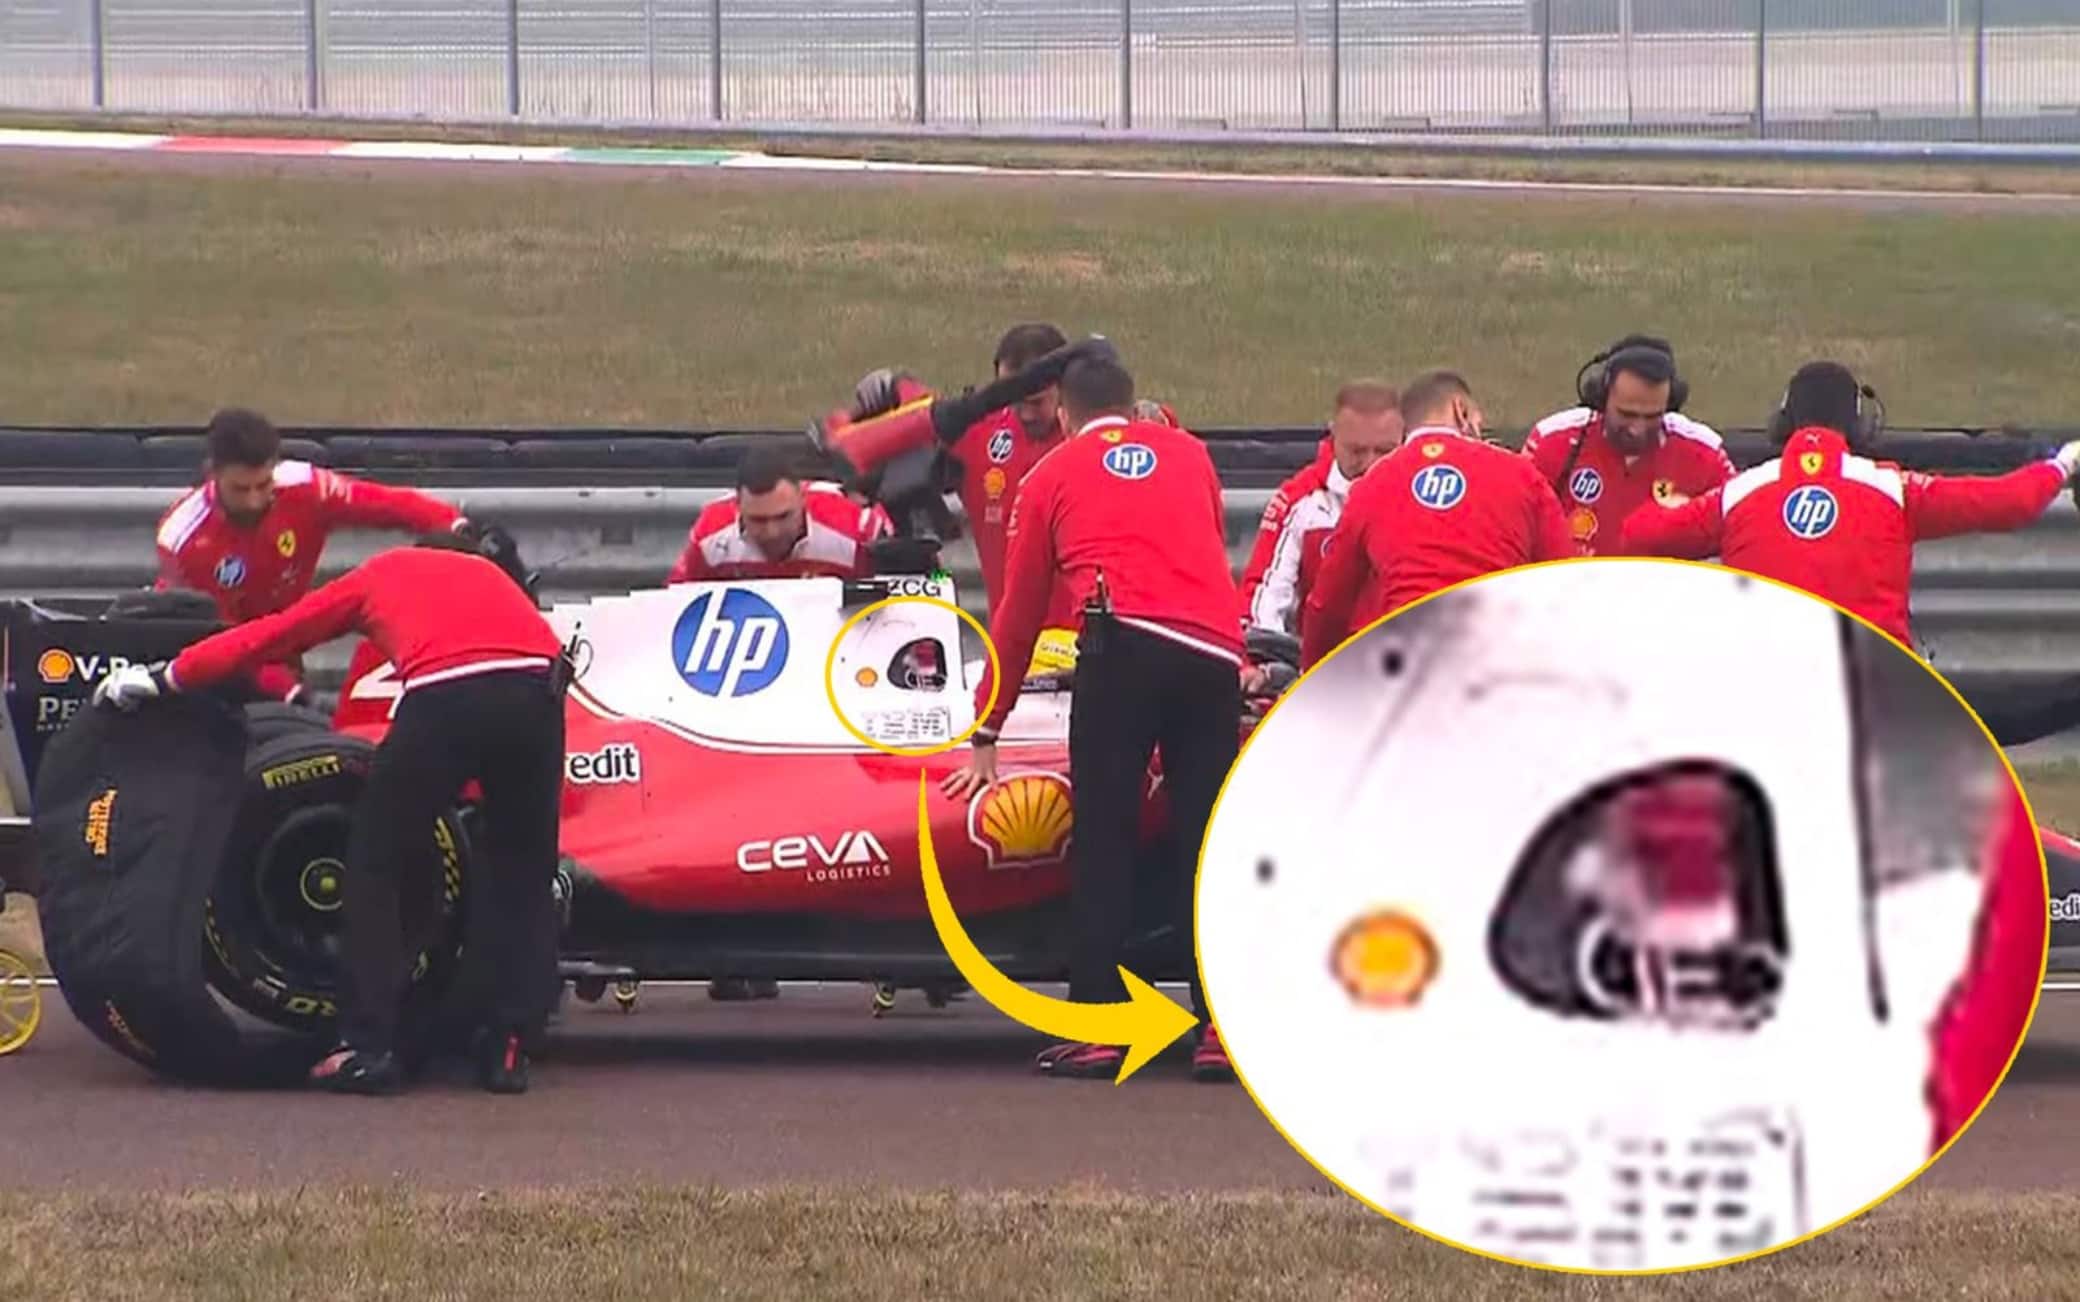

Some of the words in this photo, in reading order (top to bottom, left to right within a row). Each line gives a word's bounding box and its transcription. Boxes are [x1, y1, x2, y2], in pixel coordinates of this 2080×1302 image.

[993, 430, 1013, 462] hp
[1111, 444, 1150, 478] hp
[1420, 467, 1459, 506] hp
[1574, 467, 1599, 501] hp
[1790, 487, 1832, 536] hp
[683, 588, 780, 697] hp
[565, 747, 637, 779] edit
[806, 865, 891, 882] LOGISTICS
